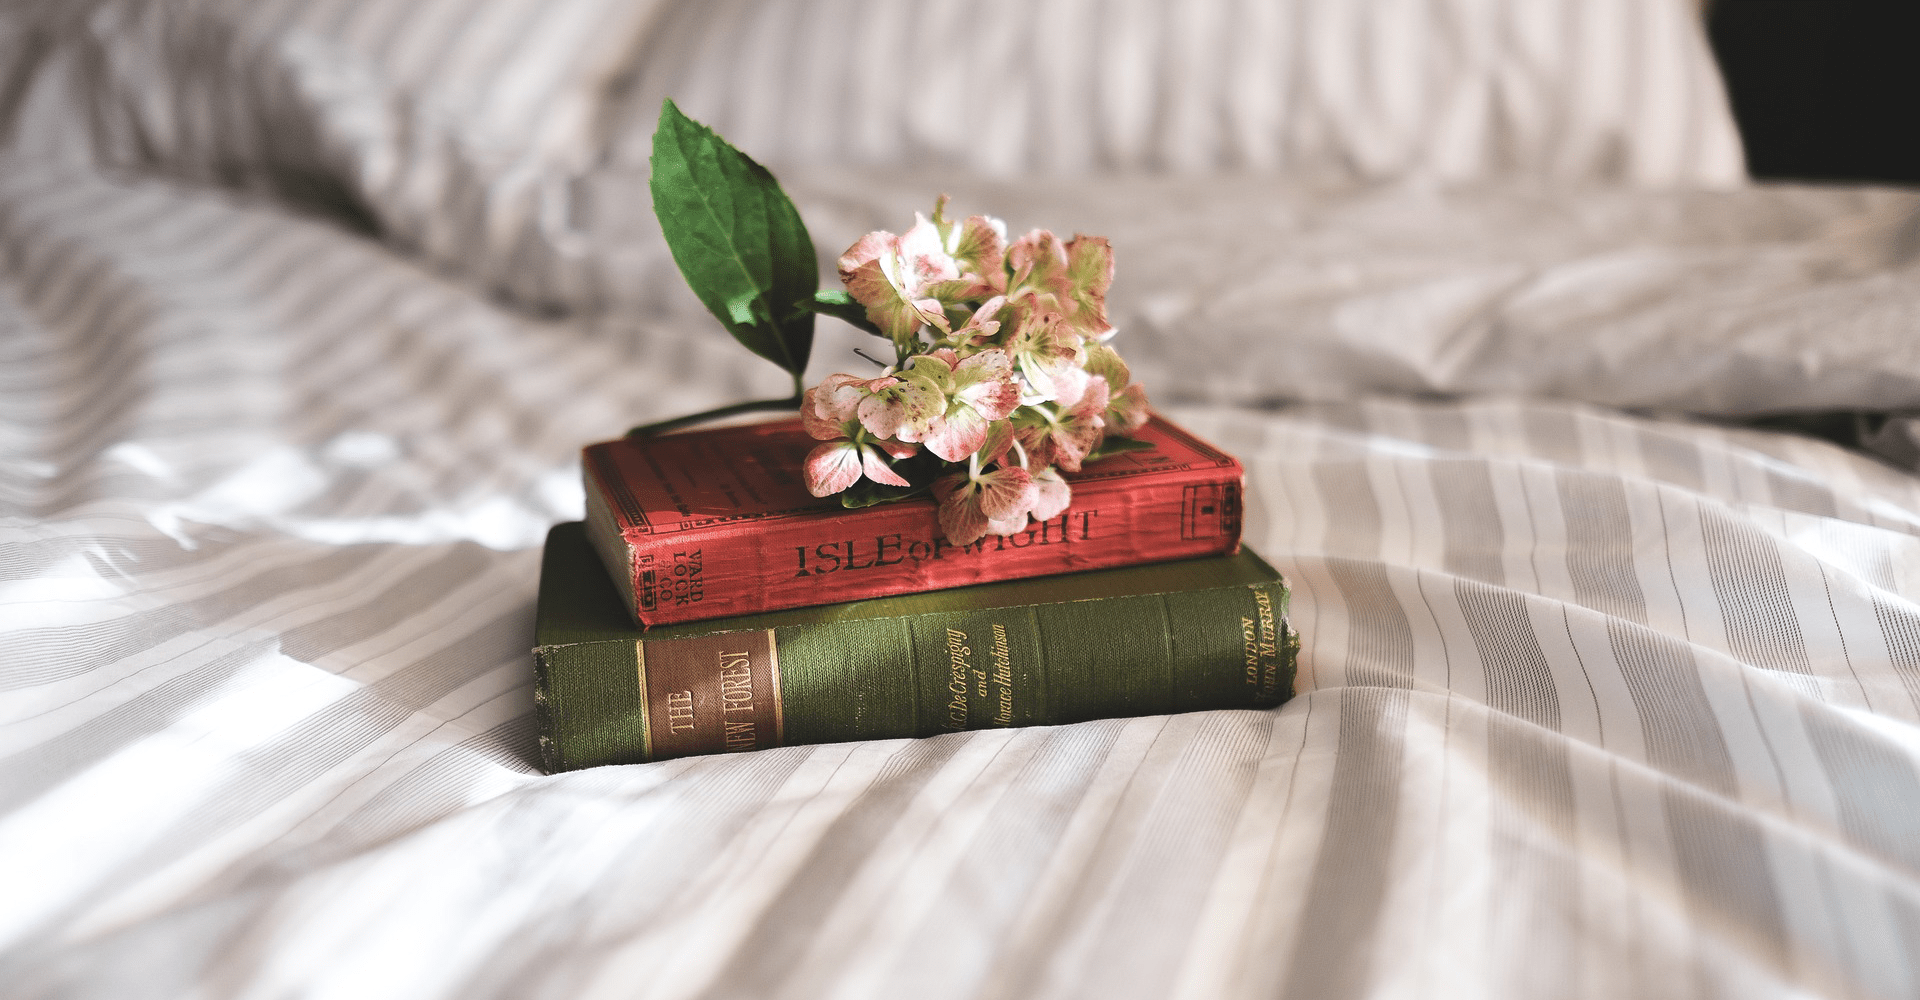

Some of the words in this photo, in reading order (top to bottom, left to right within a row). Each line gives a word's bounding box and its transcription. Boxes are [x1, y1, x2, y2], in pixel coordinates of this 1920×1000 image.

[674, 551, 689, 607] LOCK
[689, 548, 704, 602] WARD
[795, 533, 904, 578] ISLE
[659, 577, 673, 602] CO
[1242, 616, 1258, 685] LONDON
[1255, 591, 1276, 657] MURRAY
[719, 650, 754, 715] FOREST
[946, 627, 971, 695] Crespigny
[991, 624, 1012, 687] Hutchinson
[972, 669, 988, 697] and
[993, 687, 1012, 726] Horace
[668, 690, 695, 735] THE
[724, 720, 756, 753] NEW
